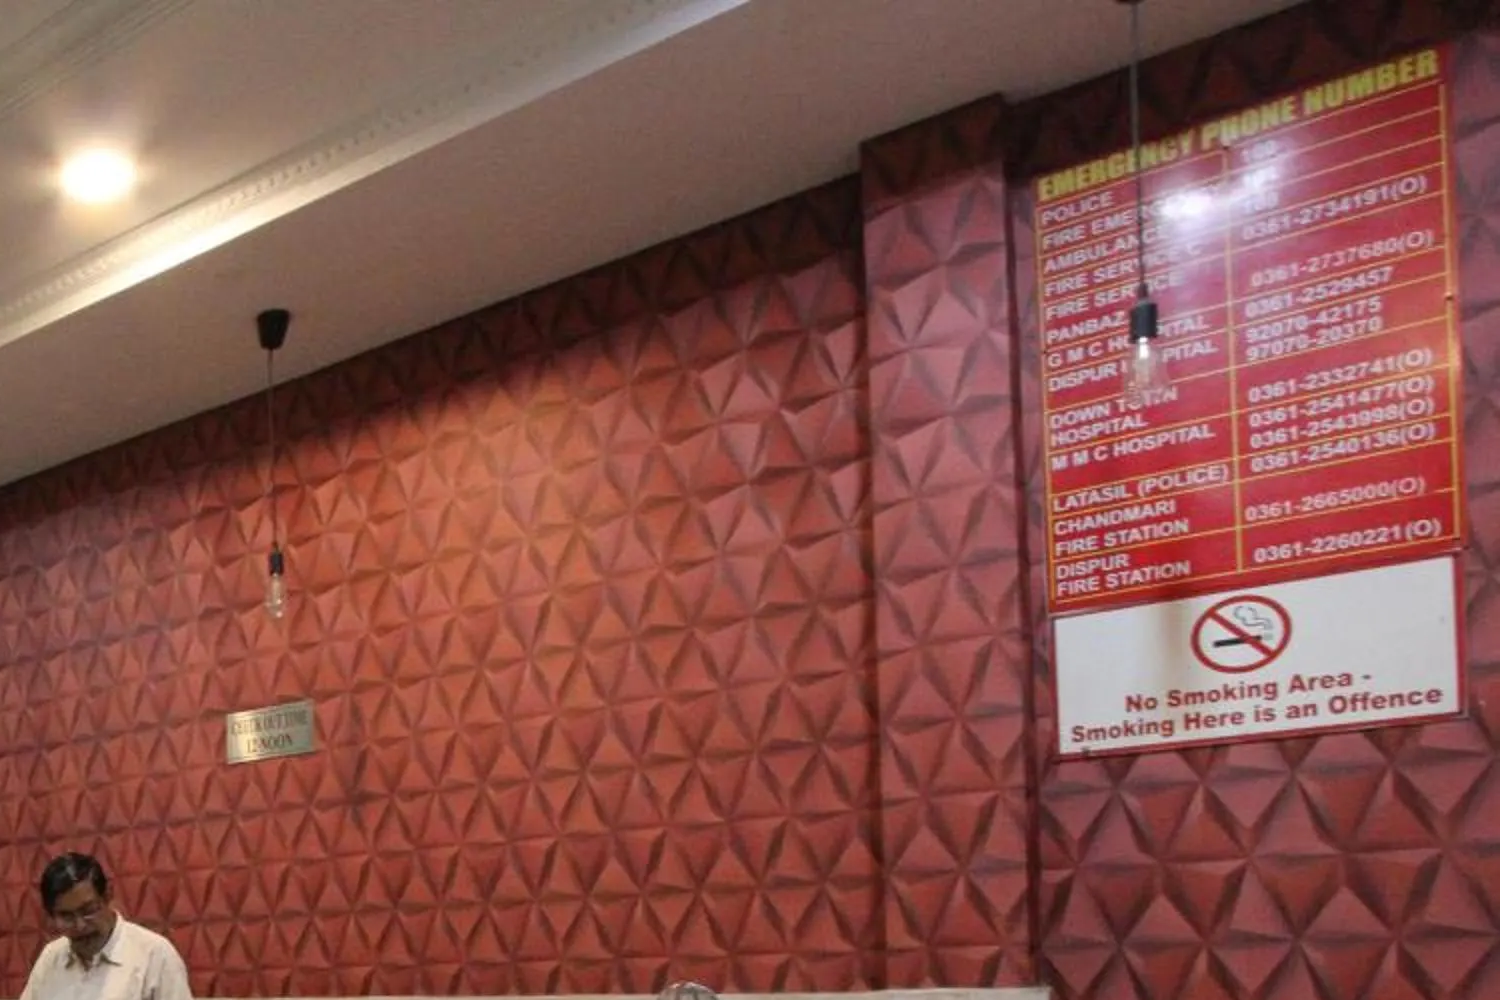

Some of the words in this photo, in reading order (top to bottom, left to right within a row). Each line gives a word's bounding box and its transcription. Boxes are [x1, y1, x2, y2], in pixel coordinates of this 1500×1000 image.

[1038, 129, 1196, 203] EMERGENCY
[1201, 95, 1297, 152] PHONE
[1302, 48, 1439, 117] NUMBER
[1042, 190, 1114, 226] POLICE
[1042, 225, 1088, 251] FIRE
[1044, 272, 1089, 298] FIRE
[1045, 295, 1090, 321] FIRE
[1066, 346, 1085, 364] M
[1087, 340, 1105, 358] C
[1049, 361, 1119, 393] DISPUR
[1050, 412, 1150, 448] HOSPITAL
[1051, 402, 1111, 430] DOWN
[1093, 445, 1110, 462] C
[1112, 423, 1218, 458] HOSPITAL
[1053, 484, 1134, 512] LATASIL
[1137, 463, 1230, 499] (POLICE)
[1055, 534, 1100, 558] FIRE
[1103, 517, 1190, 548] STATION
[1253, 523, 1402, 564] 0361-2260221
[1057, 552, 1132, 580] DISPUR
[1057, 575, 1101, 598] FIRE
[1104, 559, 1192, 589] STATION
[1124, 692, 1159, 714] No
[1167, 679, 1278, 708] Smoking
[1288, 672, 1355, 694] Area
[1071, 717, 1175, 743] Smoking
[1183, 709, 1246, 732] Here
[1253, 703, 1277, 722] is
[1285, 702, 1318, 719] an
[1328, 687, 1445, 715] Offence
